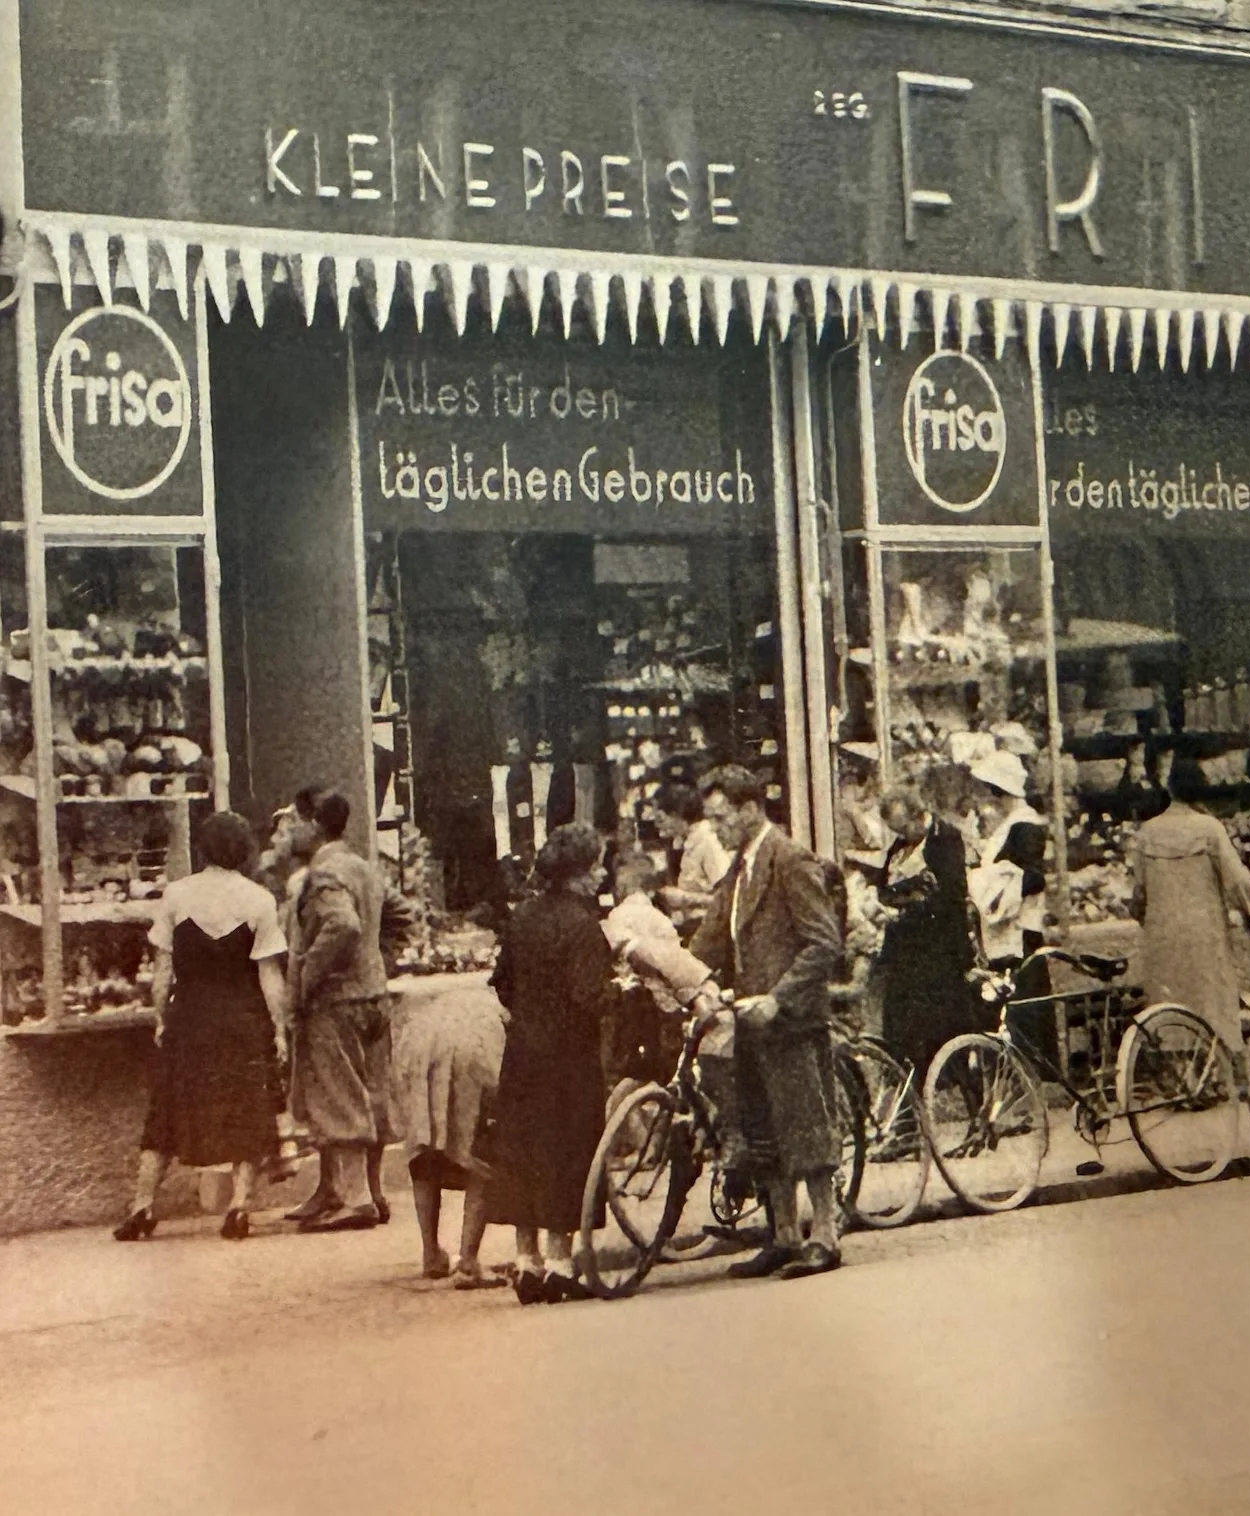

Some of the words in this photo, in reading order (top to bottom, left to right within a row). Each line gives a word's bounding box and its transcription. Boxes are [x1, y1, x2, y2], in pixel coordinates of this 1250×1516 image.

[264, 128, 497, 208] KLEINE
[523, 147, 739, 226] PREISE
[62, 338, 184, 457] frisa
[375, 357, 481, 416] Alles
[493, 362, 541, 418] für
[551, 352, 620, 420] den
[914, 377, 1003, 478] frisa
[379, 440, 572, 512] täglichen
[579, 445, 755, 508] Gebrauch
[1066, 462, 1123, 509] den
